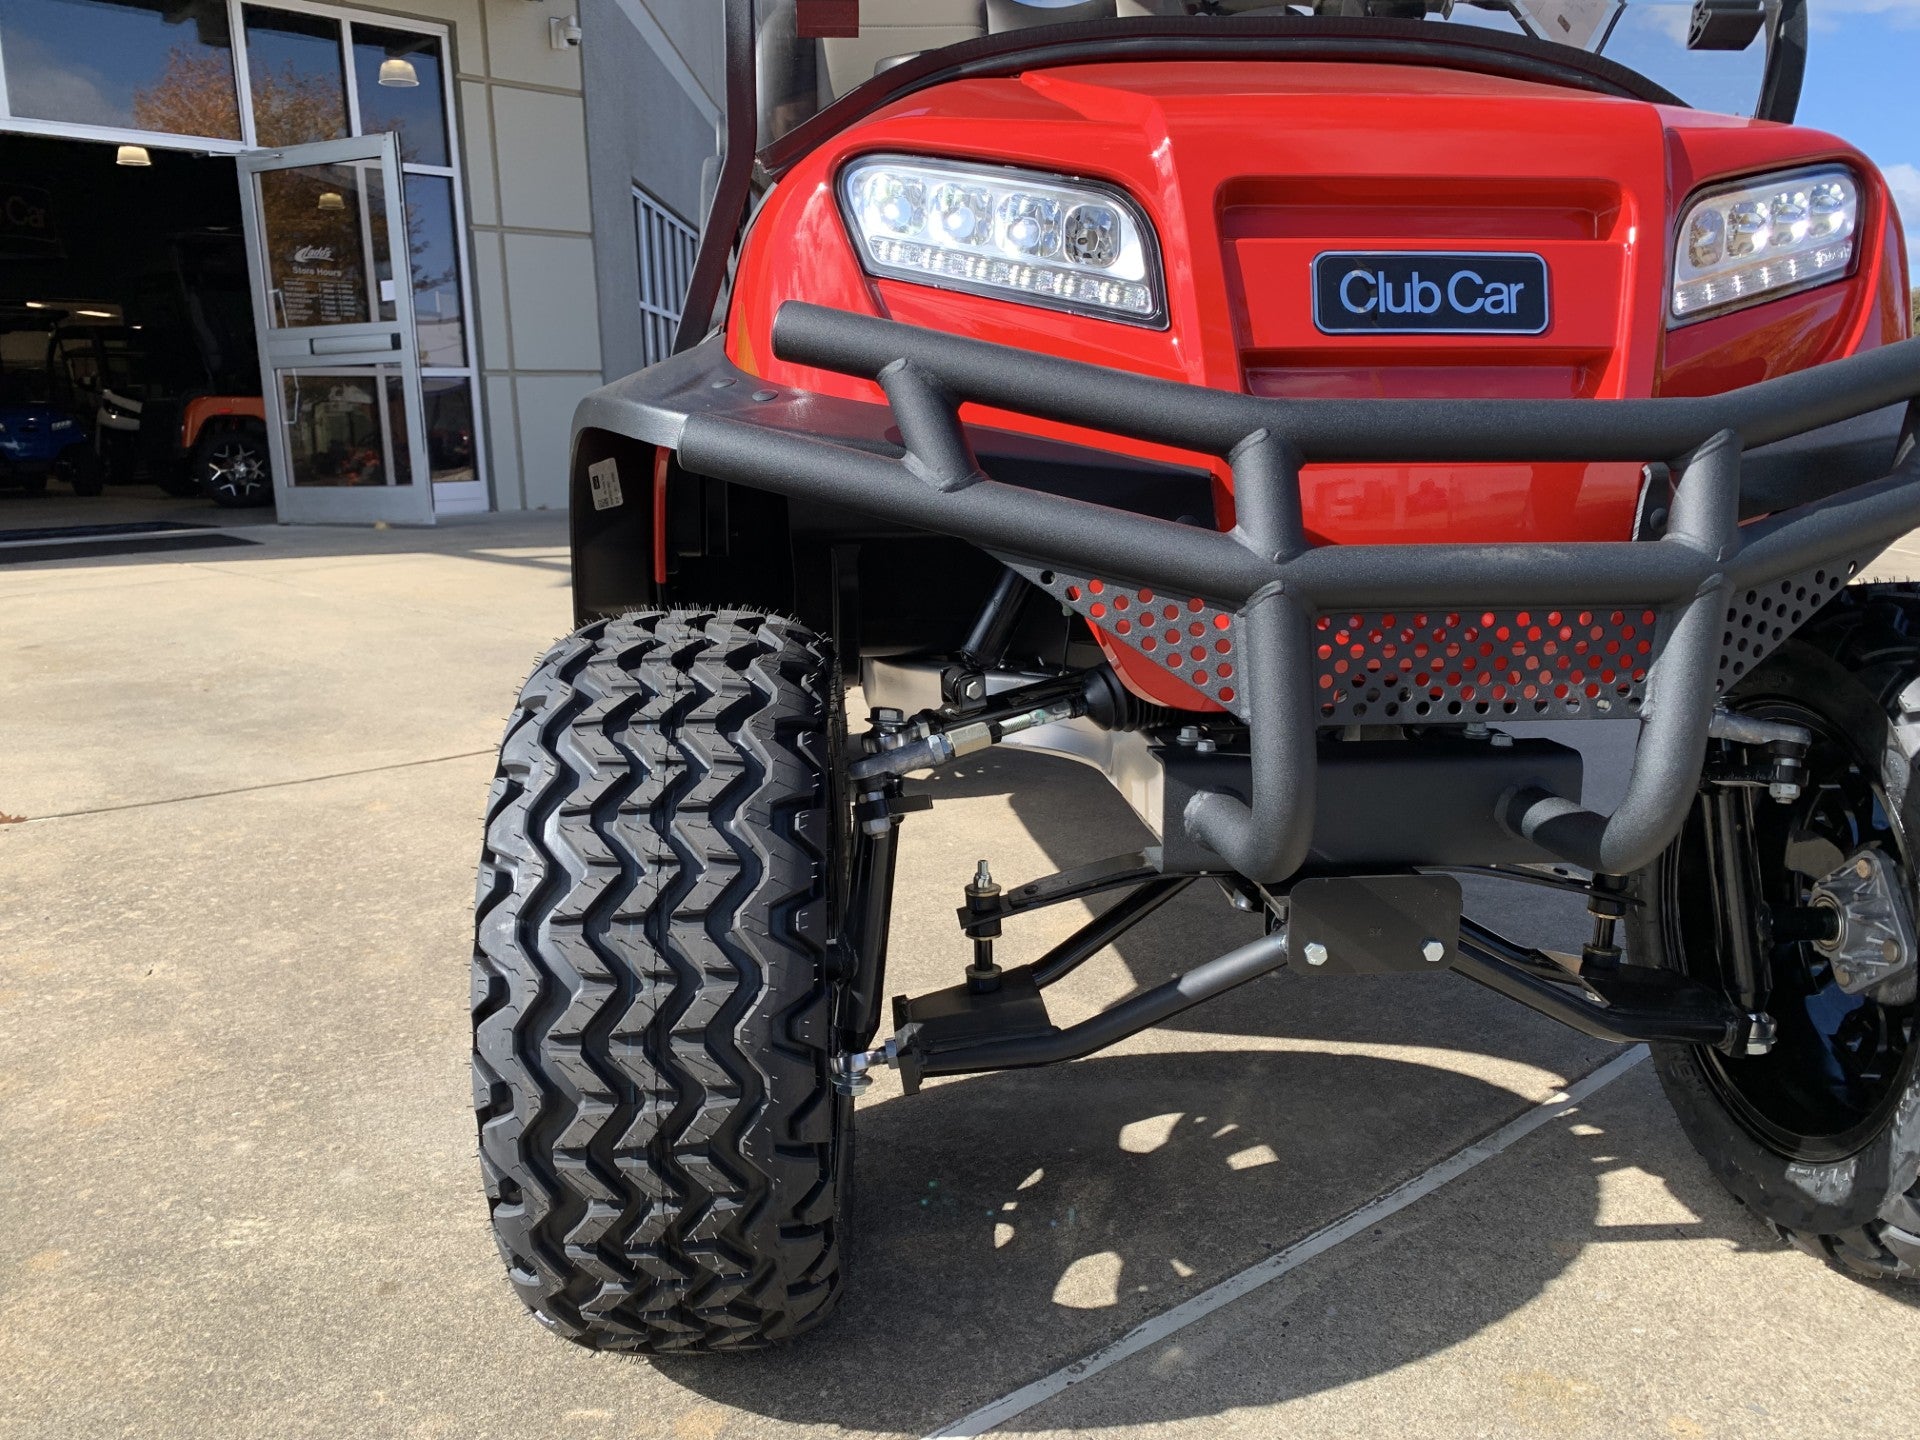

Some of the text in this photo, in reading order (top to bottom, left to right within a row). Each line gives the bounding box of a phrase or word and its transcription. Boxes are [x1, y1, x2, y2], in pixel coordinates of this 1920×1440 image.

[292, 266, 342, 277] Store Hours
[1339, 269, 1525, 315] Club Car
